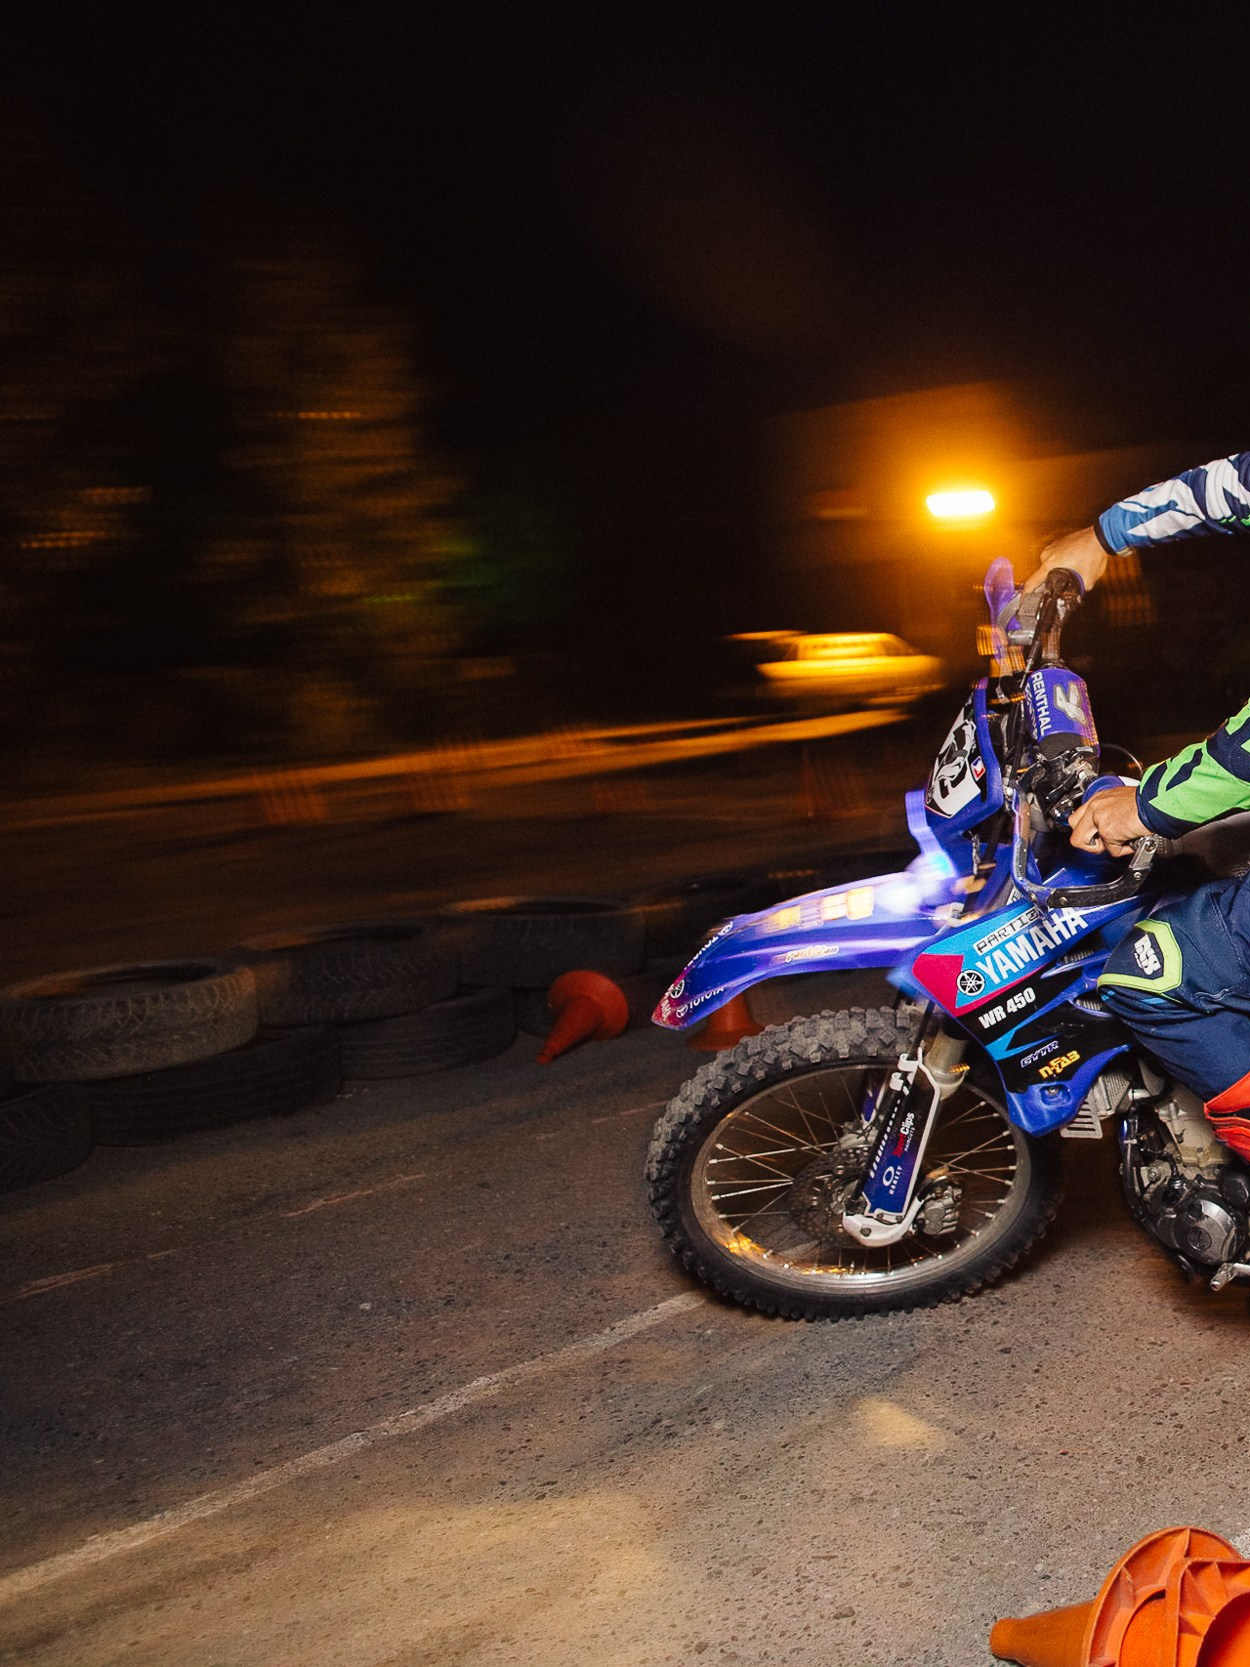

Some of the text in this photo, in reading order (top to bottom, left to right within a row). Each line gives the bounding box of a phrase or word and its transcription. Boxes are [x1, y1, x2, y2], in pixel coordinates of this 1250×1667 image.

[1031, 672, 1052, 737] RENTHAL
[975, 907, 1088, 985] YAMAHA
[978, 987, 1036, 1029] WR 450
[1020, 1040, 1060, 1067] GYTR
